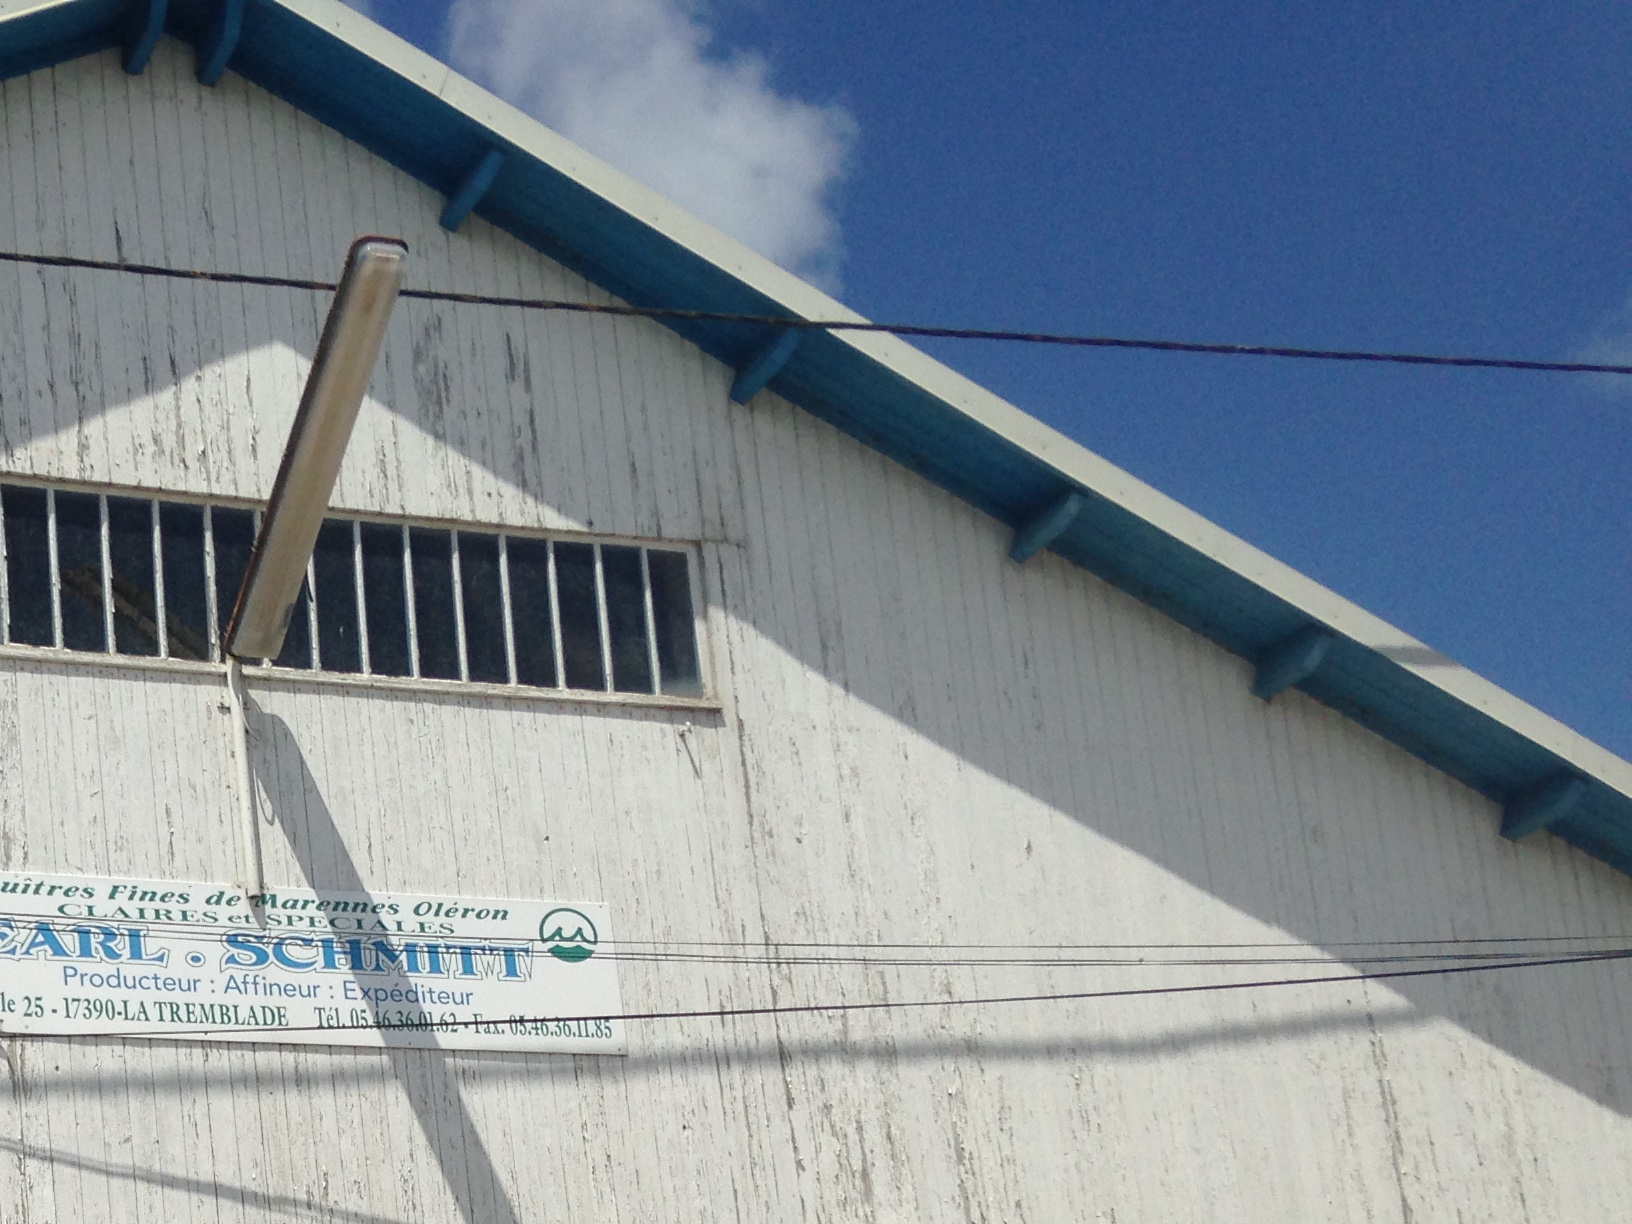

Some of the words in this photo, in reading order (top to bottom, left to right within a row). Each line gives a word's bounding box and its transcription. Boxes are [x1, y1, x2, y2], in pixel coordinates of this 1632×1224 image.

[57, 904, 219, 924] CLAIRES
[227, 914, 254, 924] et
[266, 914, 455, 935] SPECIALES
[108, 885, 191, 905] Fines
[205, 891, 243, 907] de
[254, 893, 400, 915] Marennes
[413, 901, 509, 920] Oléron
[221, 930, 532, 980] SCHMITT
[63, 966, 202, 992] Producteur
[224, 974, 321, 998] Affineur
[343, 980, 474, 1006] Expéditeur
[23, 996, 44, 1018] 25
[154, 1002, 289, 1027] TREMBLADE
[314, 1006, 346, 1029] Tél.
[472, 1013, 505, 1034] Fax.
